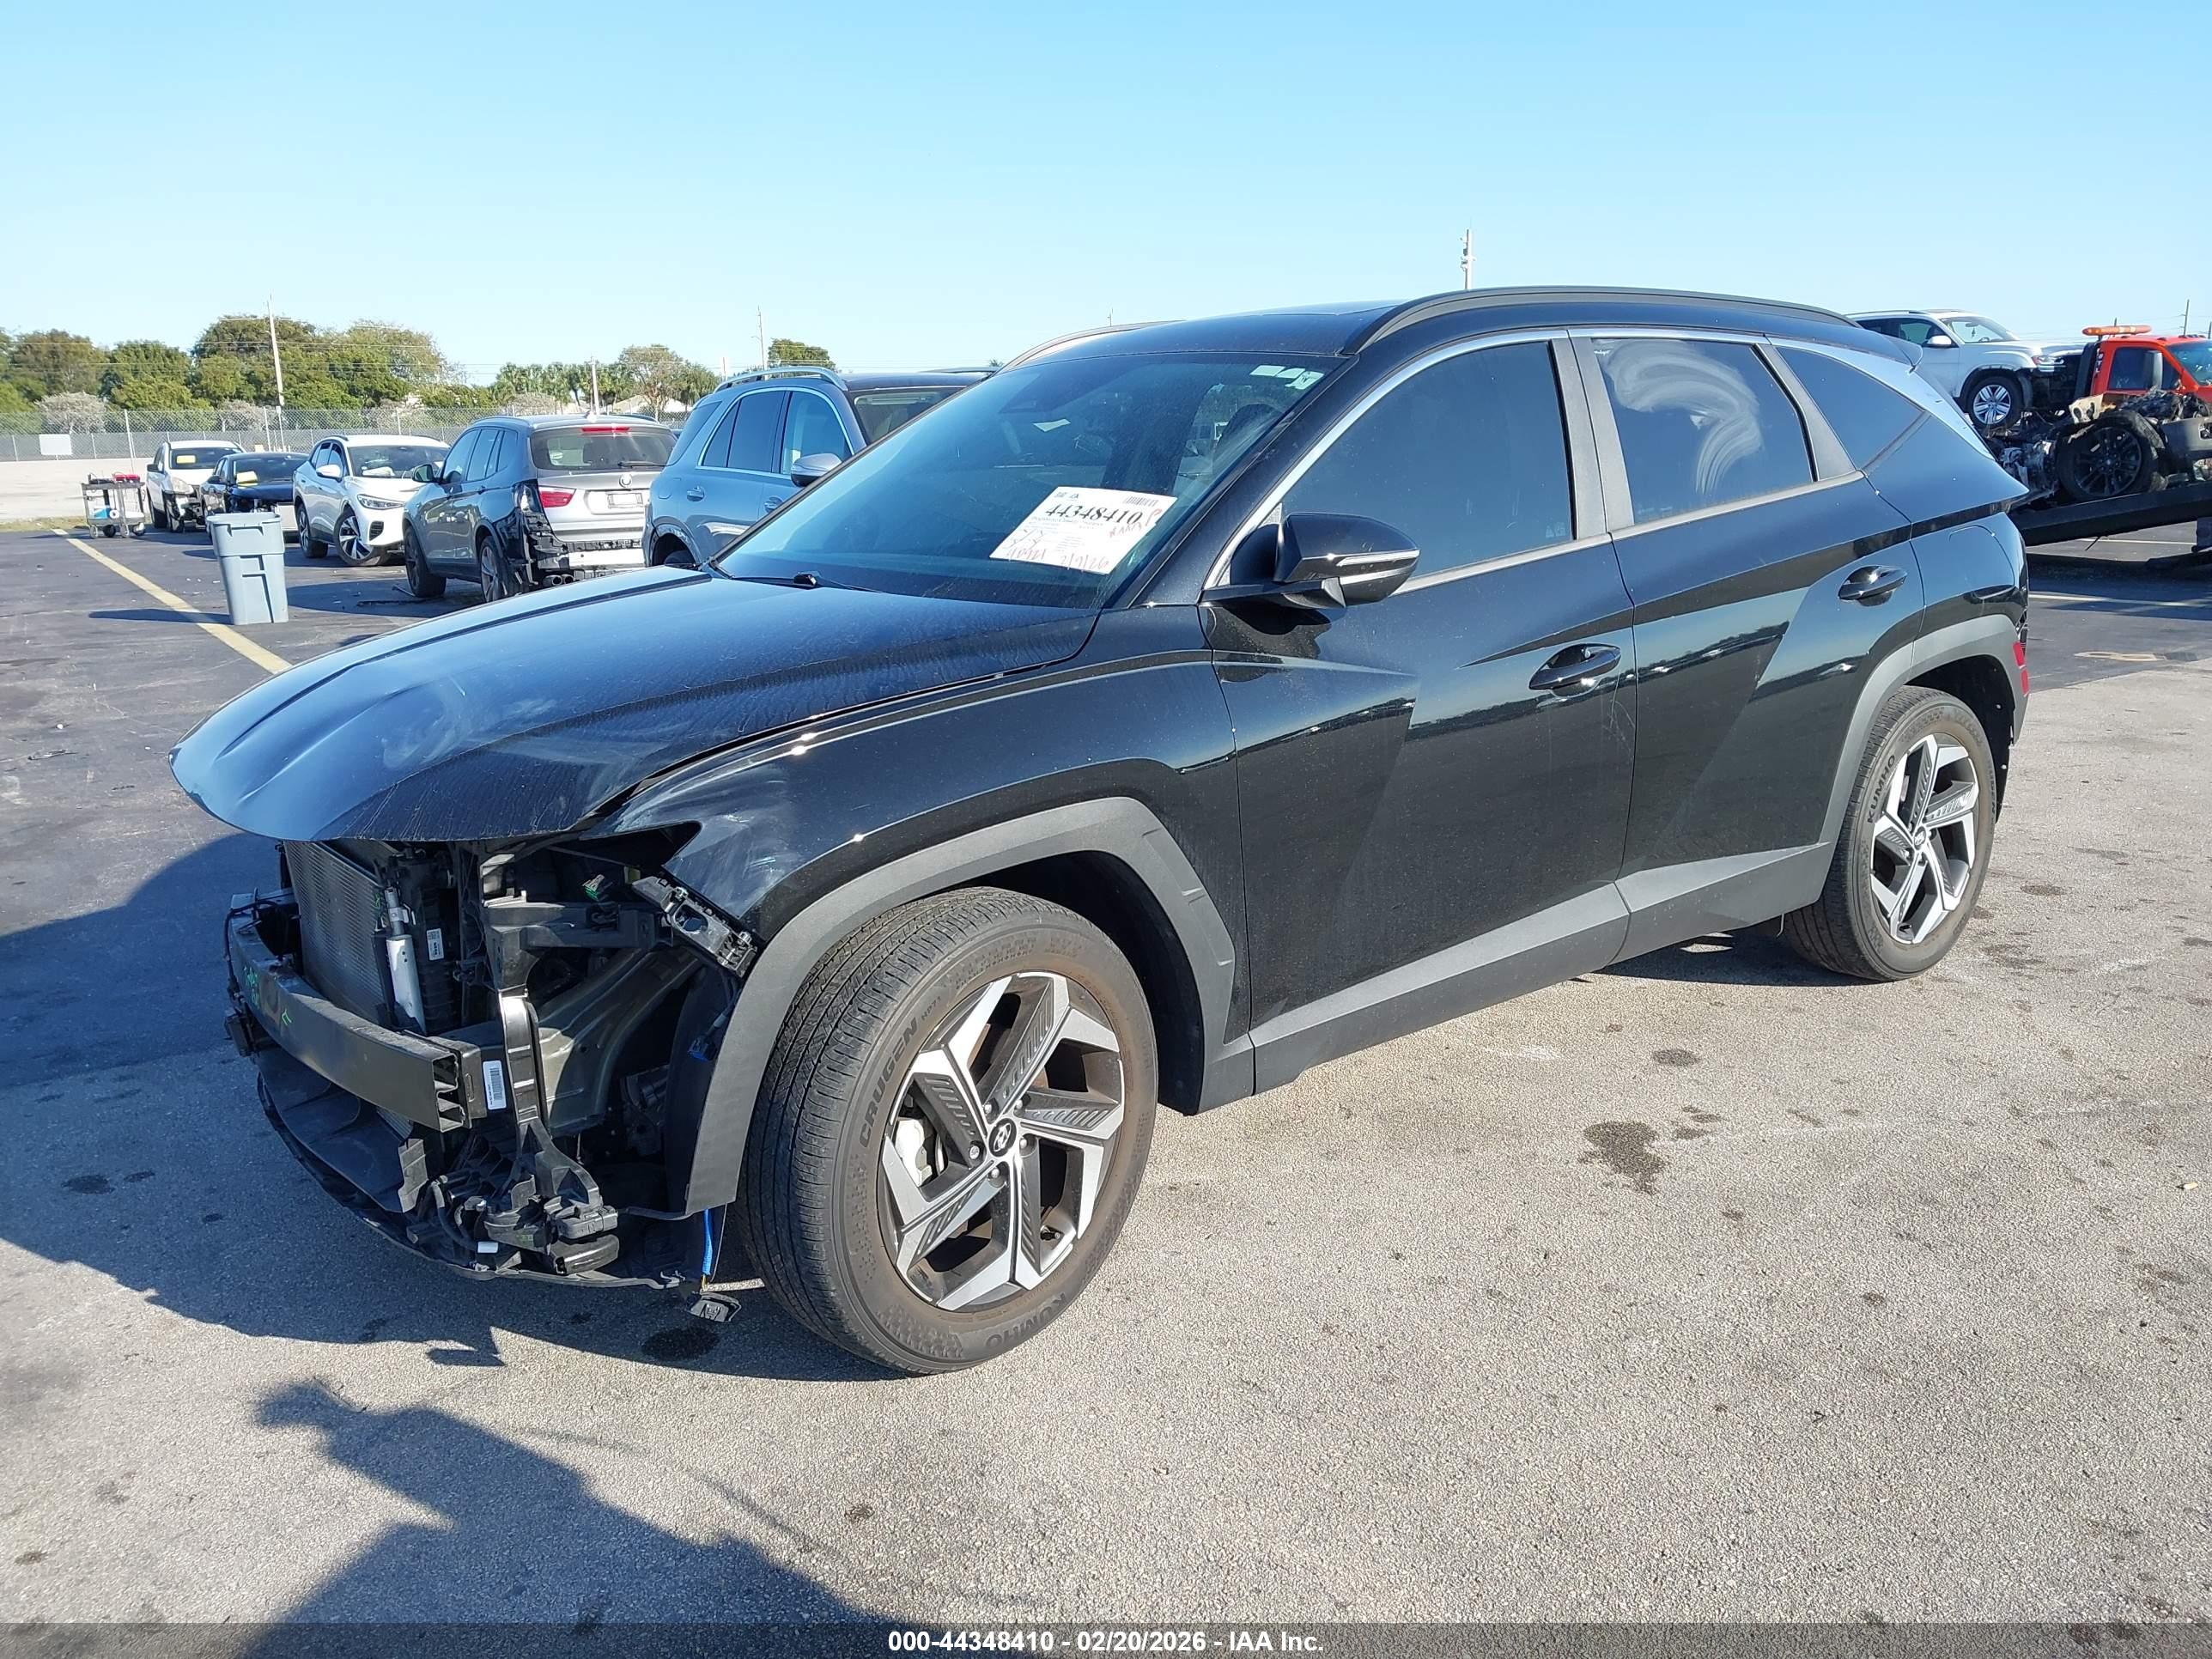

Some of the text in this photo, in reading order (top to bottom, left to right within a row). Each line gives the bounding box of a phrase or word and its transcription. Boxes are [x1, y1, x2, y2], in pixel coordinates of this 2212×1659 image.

[1045, 503, 1143, 525] 44348410
[1867, 755, 1895, 823] KUMHO
[859, 1017, 918, 1148] CRUGEN
[984, 1291, 1066, 1348] KUMHO
